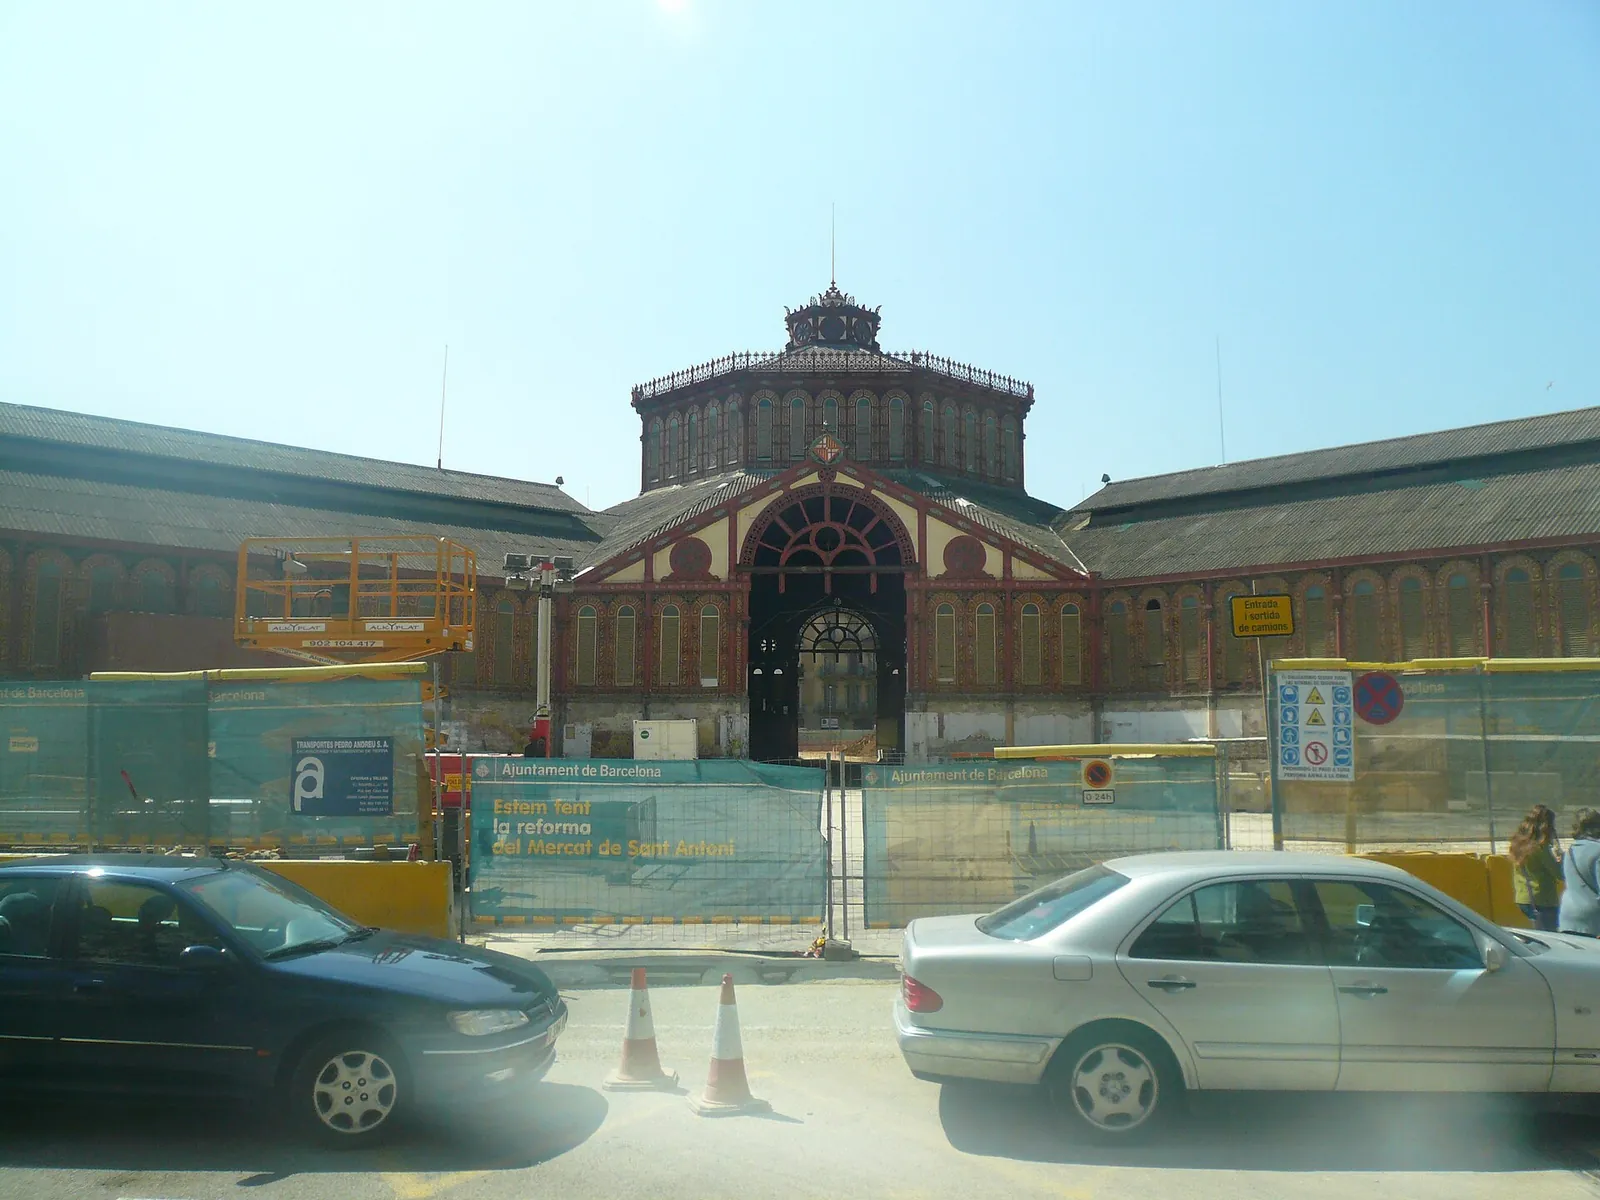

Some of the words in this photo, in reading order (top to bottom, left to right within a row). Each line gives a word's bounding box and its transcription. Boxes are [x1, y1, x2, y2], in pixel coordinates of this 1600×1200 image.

[1244, 599, 1278, 609] Entrada
[1250, 611, 1281, 620] sortida
[1238, 623, 1250, 632] de
[1251, 622, 1288, 632] camions
[28, 686, 85, 699] Barcelona
[502, 763, 579, 778] Ajuntament
[581, 764, 597, 776] de
[600, 765, 661, 777] Barcelona
[892, 769, 967, 784] Ajuntament
[969, 768, 985, 780] de
[988, 766, 1048, 781] Barcelona
[494, 799, 547, 815] Estem
[554, 799, 591, 815] fent
[493, 818, 510, 835] la
[517, 818, 591, 835] reforma
[492, 838, 521, 855] del
[527, 839, 592, 855] Mercat
[598, 838, 622, 855] de
[627, 839, 670, 857] Sant
[674, 838, 736, 856] Antoni
